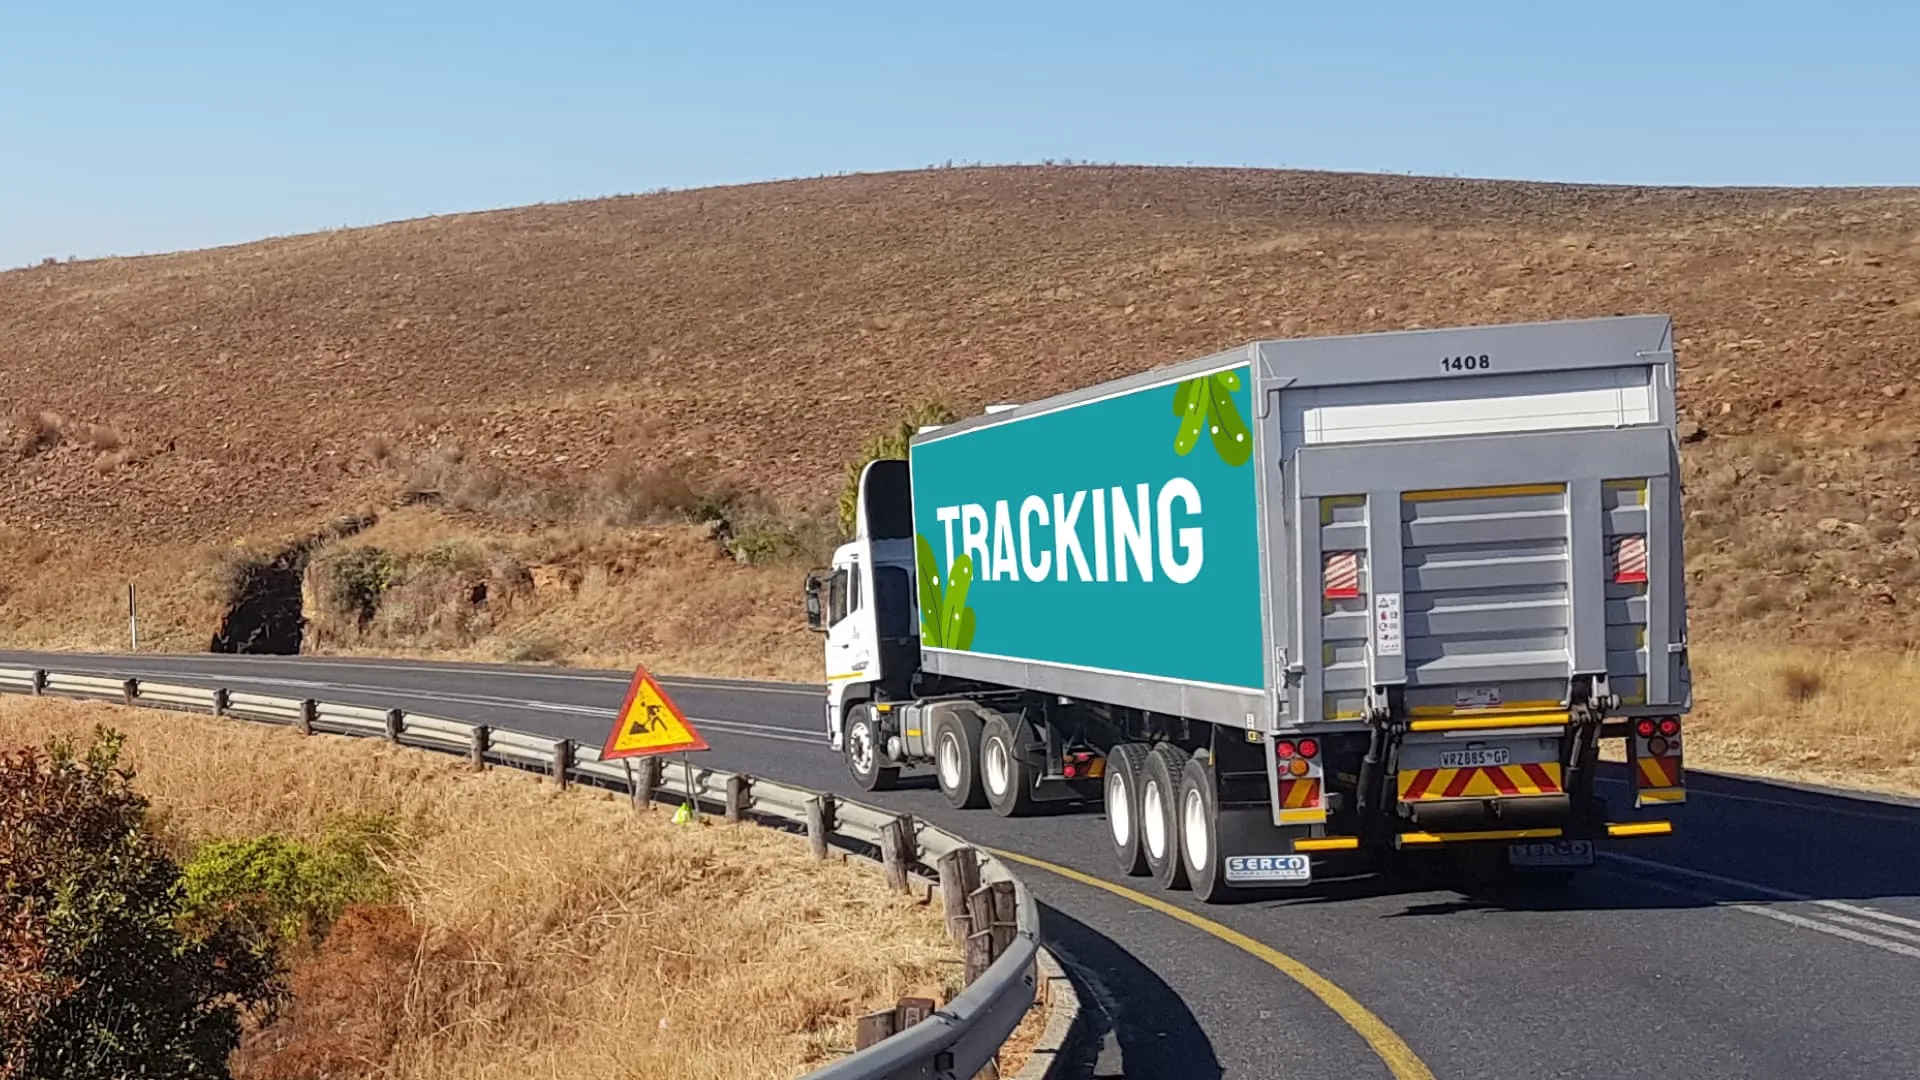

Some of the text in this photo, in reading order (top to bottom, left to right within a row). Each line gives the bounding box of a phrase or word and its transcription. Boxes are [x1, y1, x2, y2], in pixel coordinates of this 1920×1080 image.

[1441, 355, 1490, 371] 1408
[936, 477, 1204, 584] TRACKING
[1494, 750, 1508, 763] GP
[1231, 858, 1302, 870] SERCO
